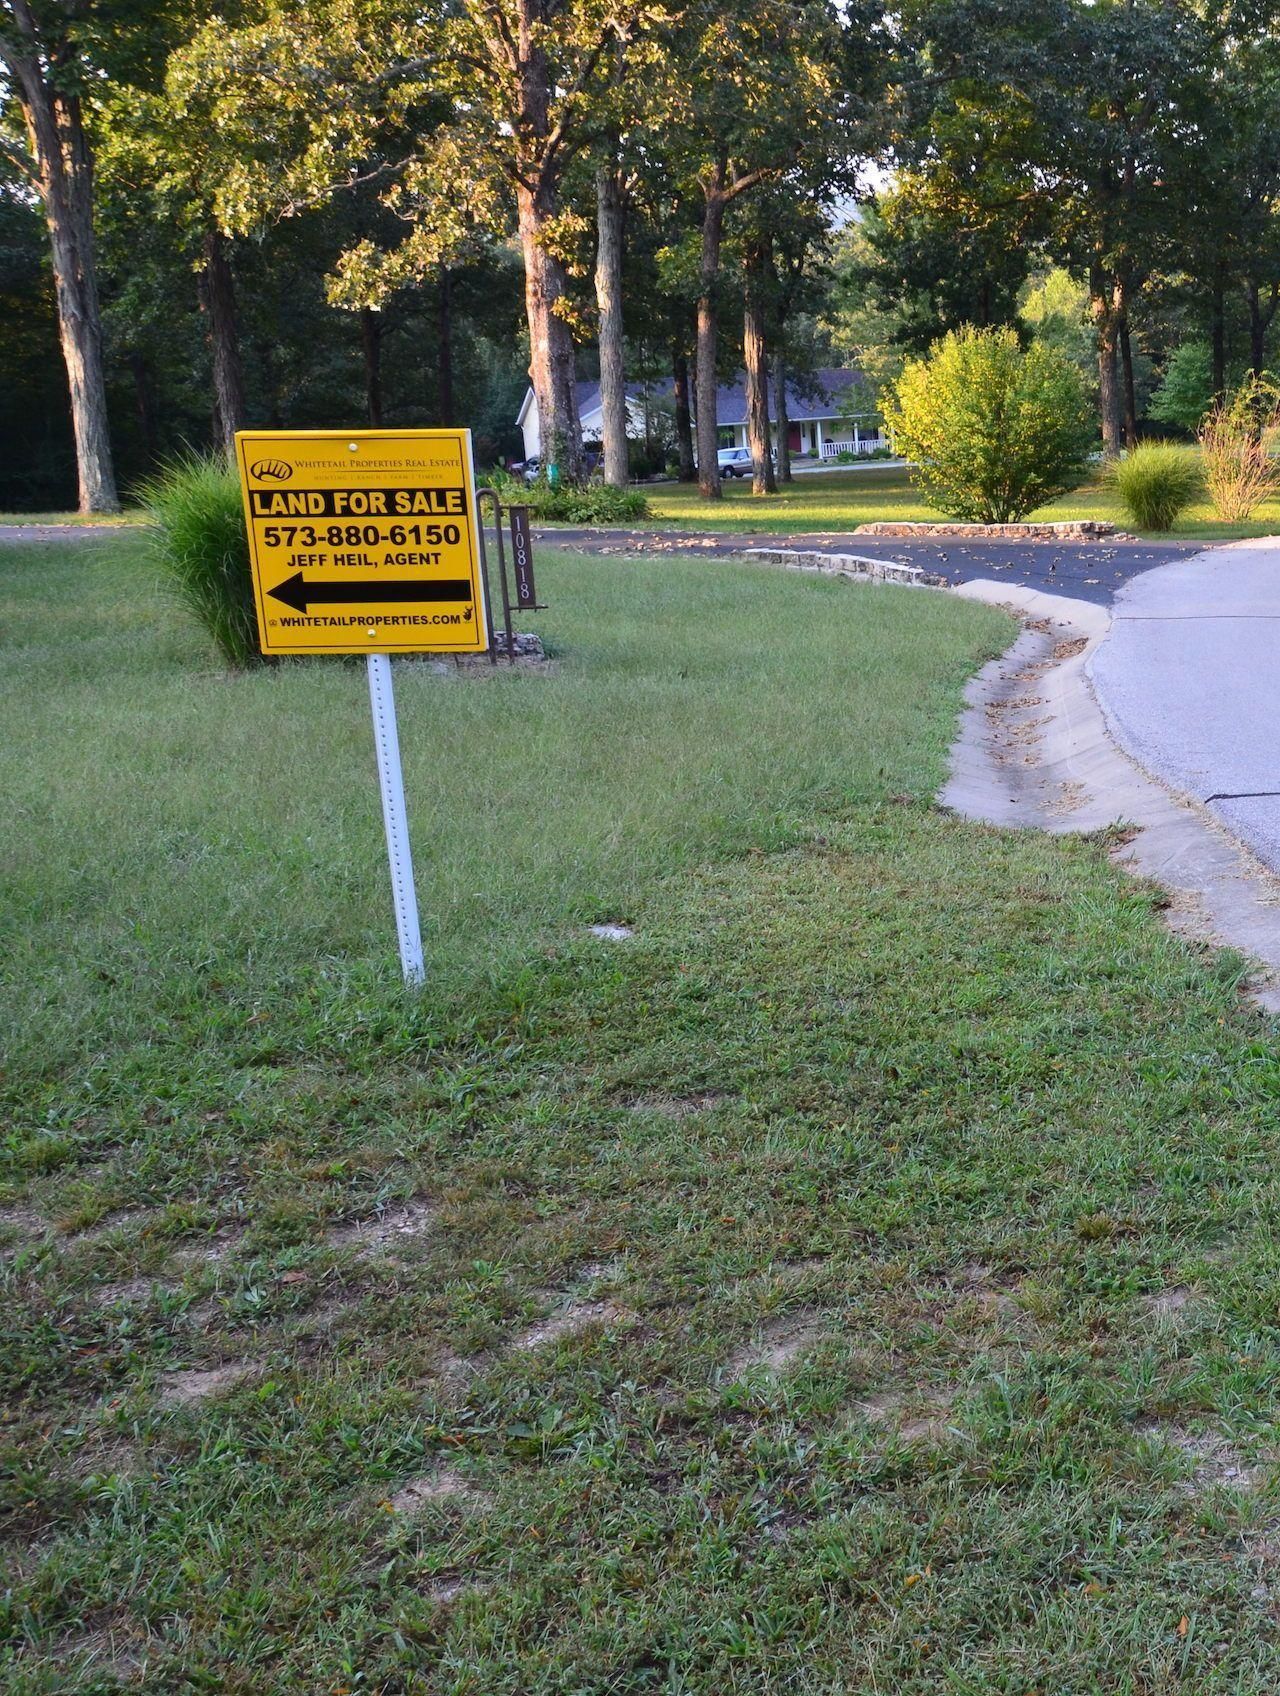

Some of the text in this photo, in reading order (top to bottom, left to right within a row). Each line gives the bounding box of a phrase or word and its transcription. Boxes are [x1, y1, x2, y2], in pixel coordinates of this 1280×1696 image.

[253, 490, 463, 515] LAND FOR SALE
[263, 524, 461, 547] 573-880-6150
[287, 552, 442, 568] JEFF HEIL, AGENT
[279, 614, 461, 627] WHITETAILPROPERTIES.COM
